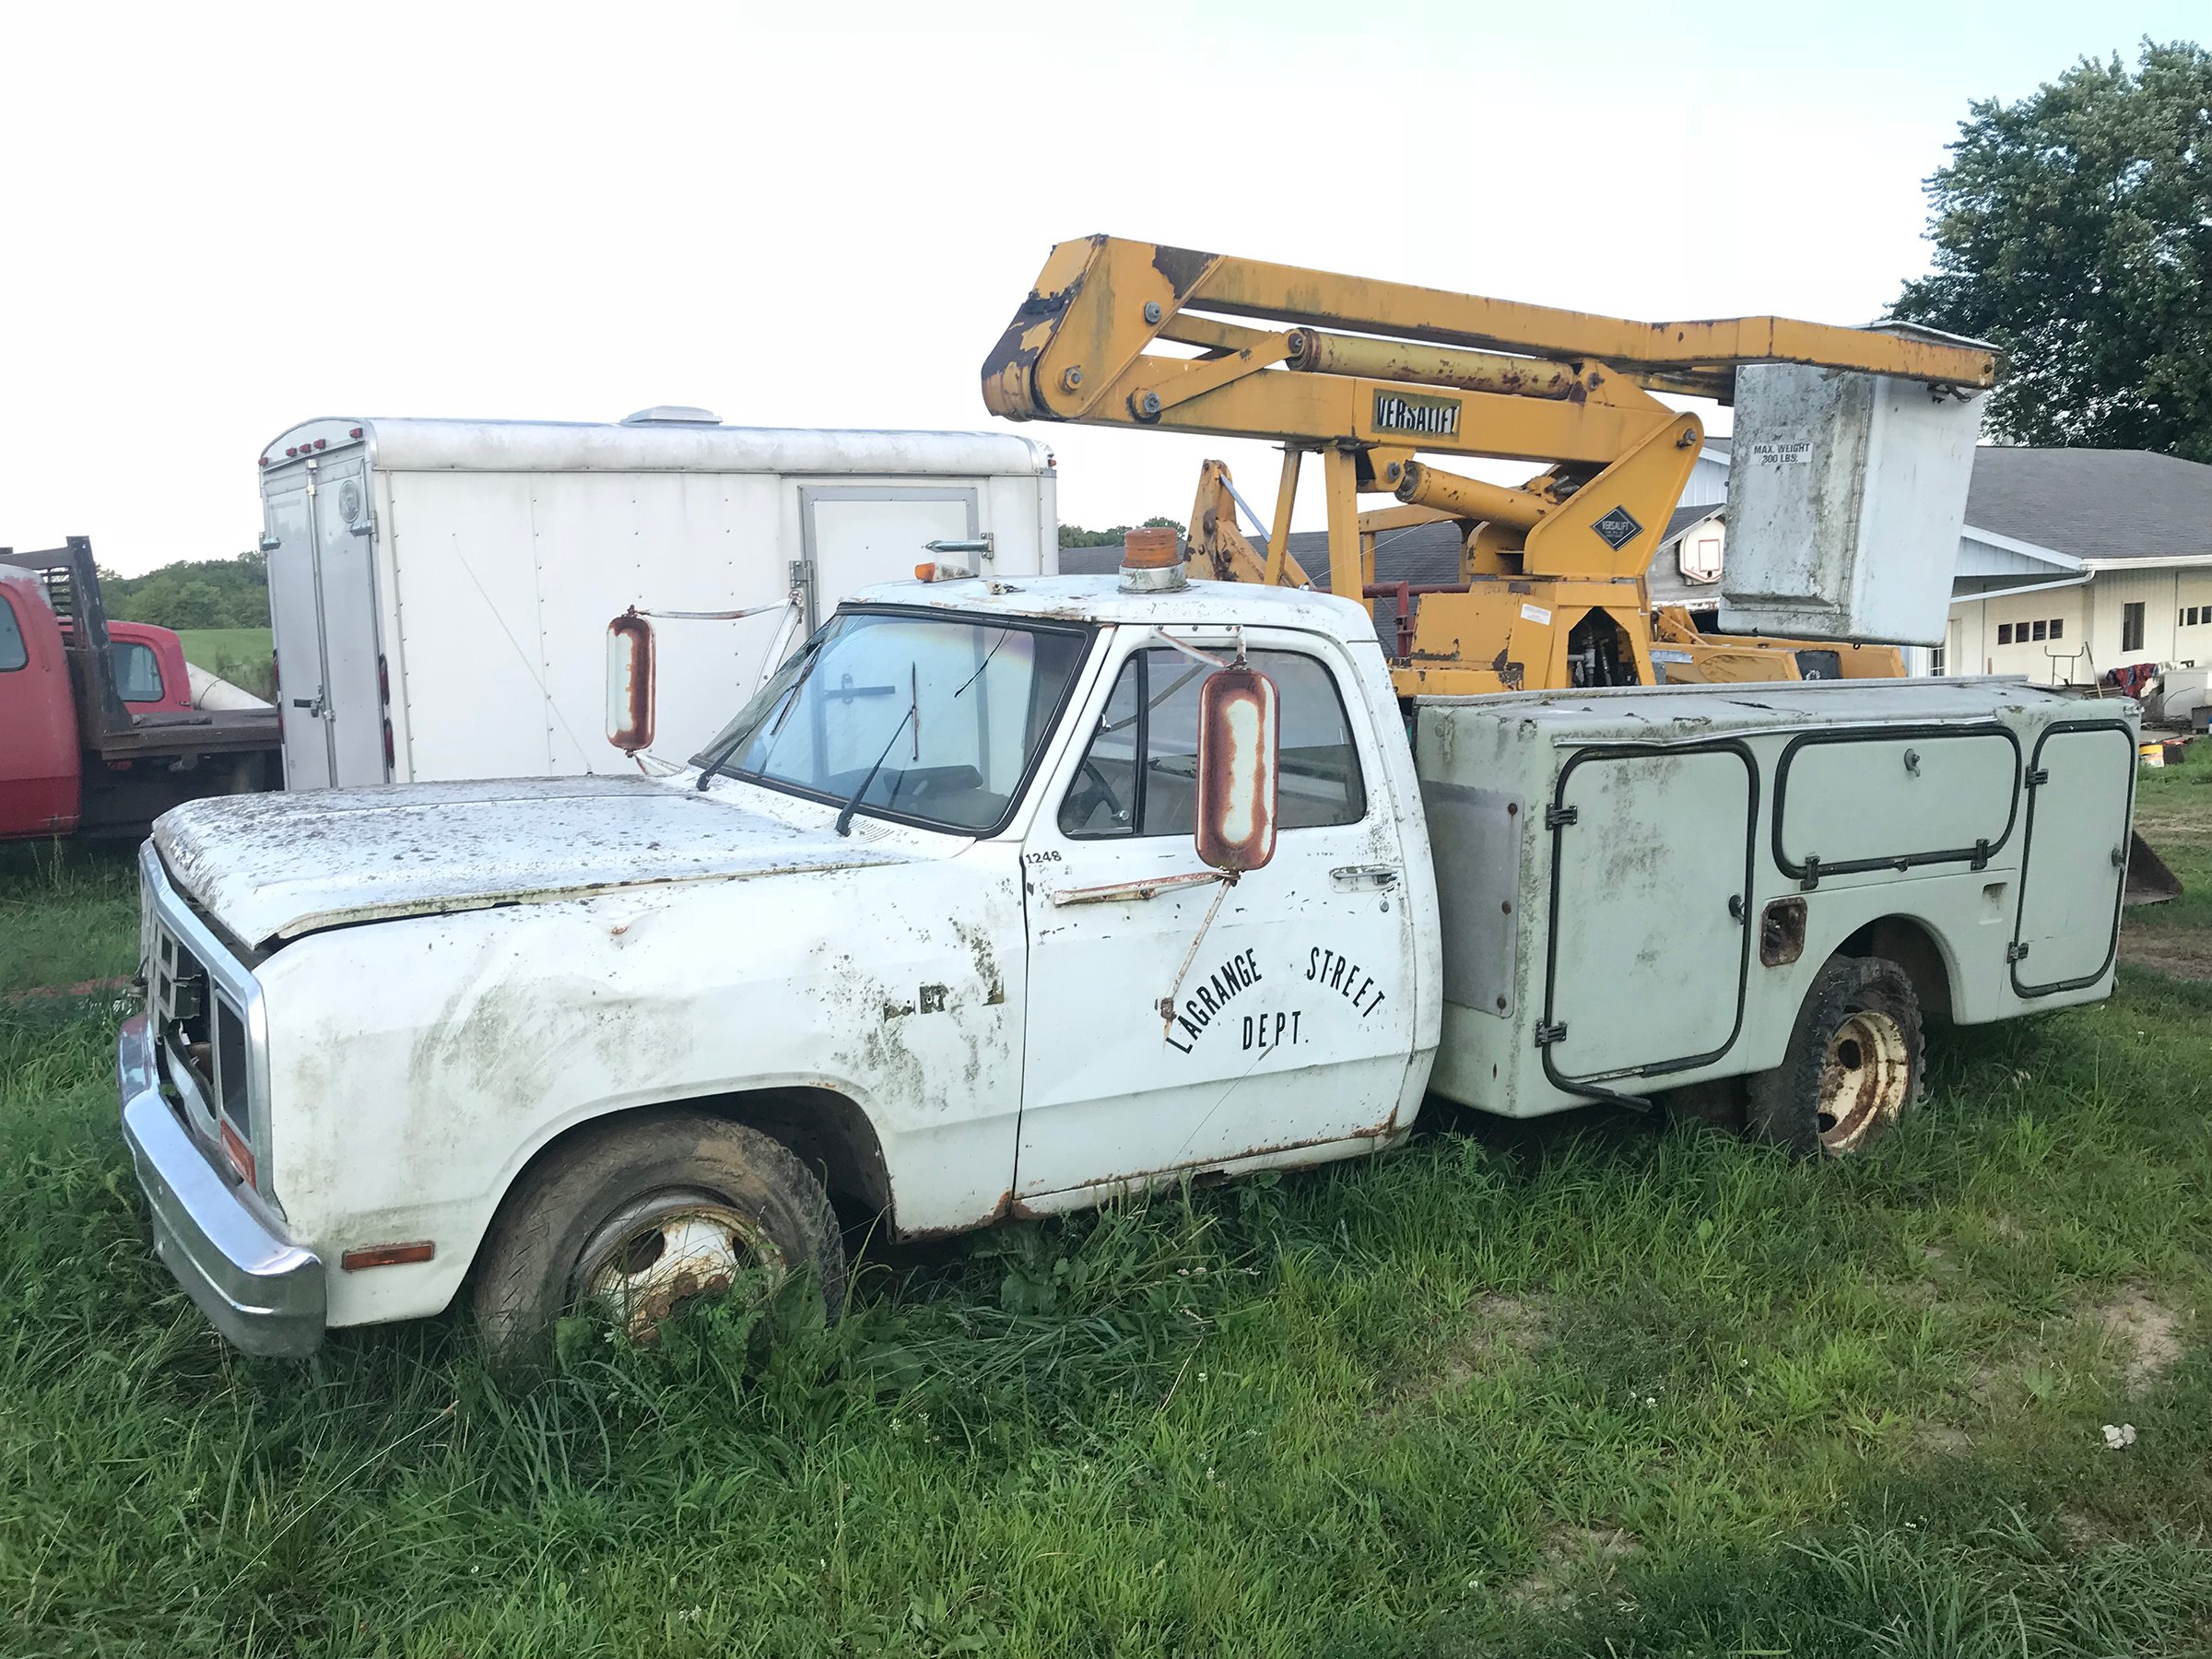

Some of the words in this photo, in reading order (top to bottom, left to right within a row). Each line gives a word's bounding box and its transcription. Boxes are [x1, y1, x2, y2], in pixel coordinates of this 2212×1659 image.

[1377, 396, 1460, 434] VERSALIFT
[1753, 445, 1775, 454] MAX.
[1777, 443, 1810, 453] WEIGHT
[1025, 851, 1062, 864] 1248
[1166, 948, 1263, 1054] LAGRANGE
[1307, 947, 1385, 1018] STREET
[1242, 1011, 1310, 1050] DEPT.
